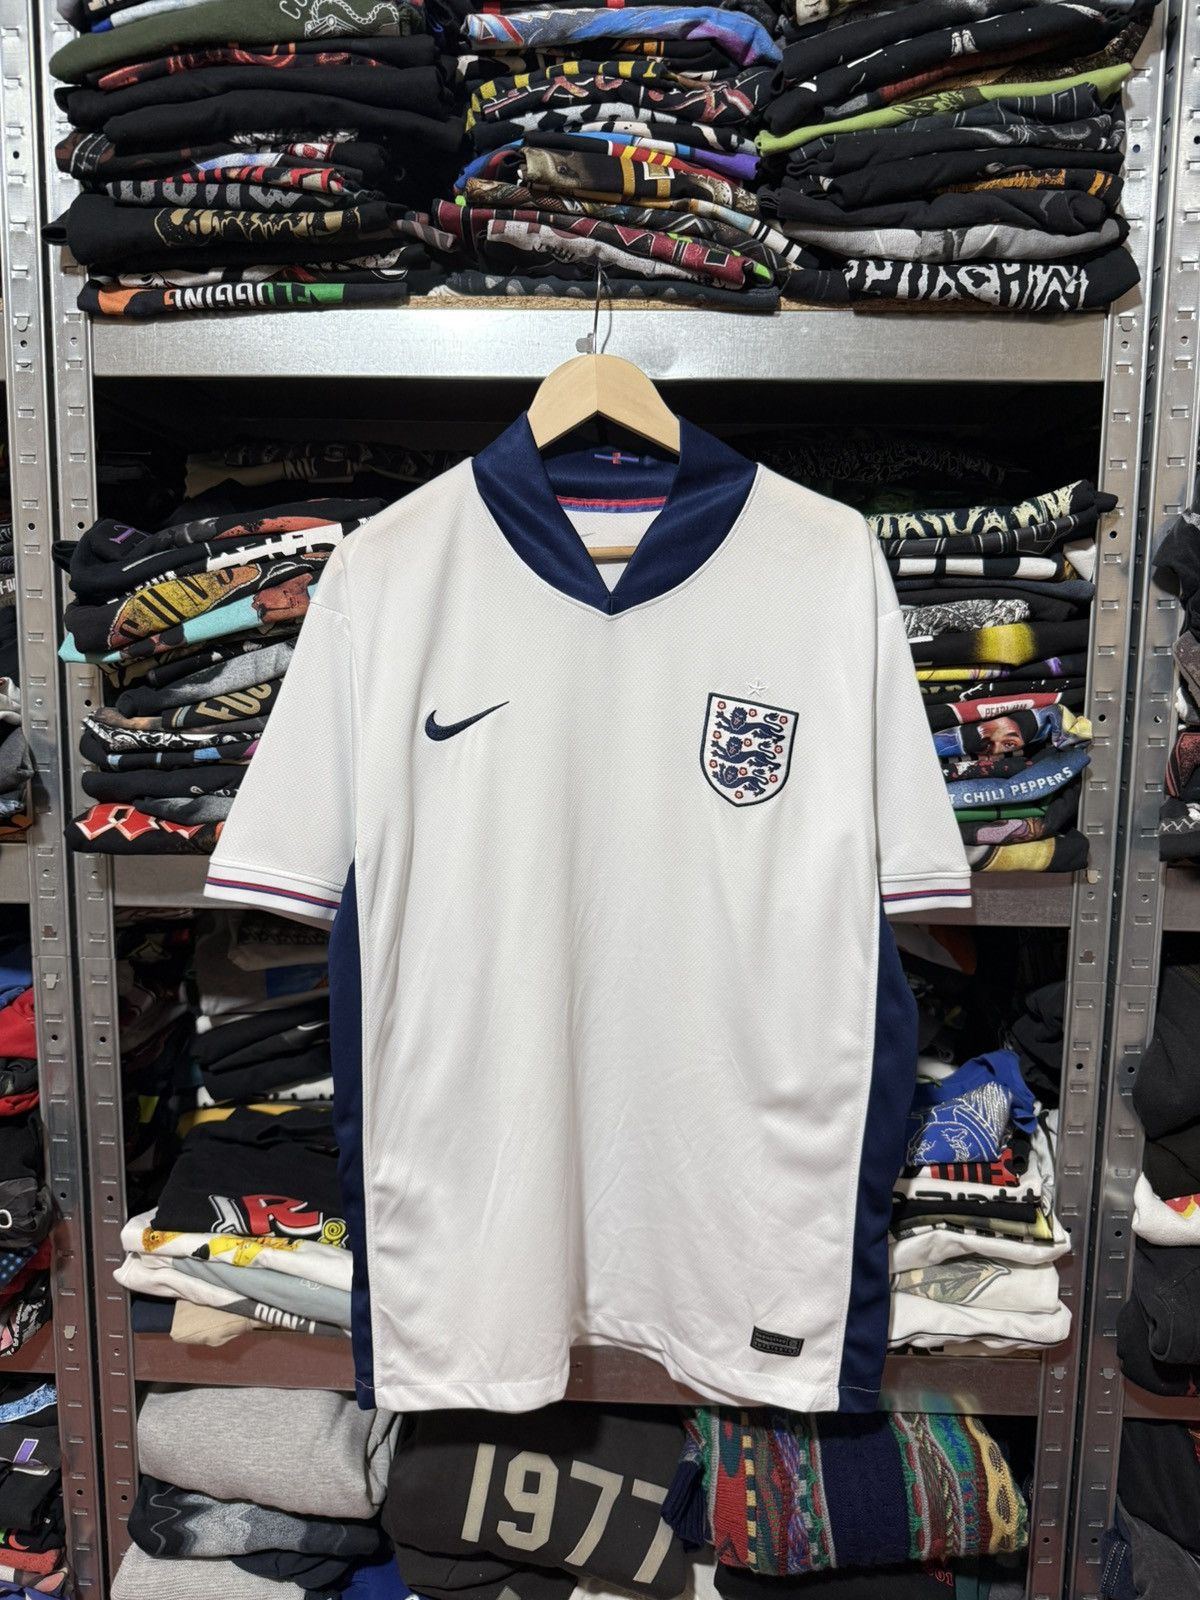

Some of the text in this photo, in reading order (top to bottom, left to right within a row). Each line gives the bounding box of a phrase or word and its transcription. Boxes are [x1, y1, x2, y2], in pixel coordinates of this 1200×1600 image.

[963, 788, 1005, 804] CHILI
[1011, 767, 1073, 797] PEPPERS
[461, 1442, 673, 1584] 1977
